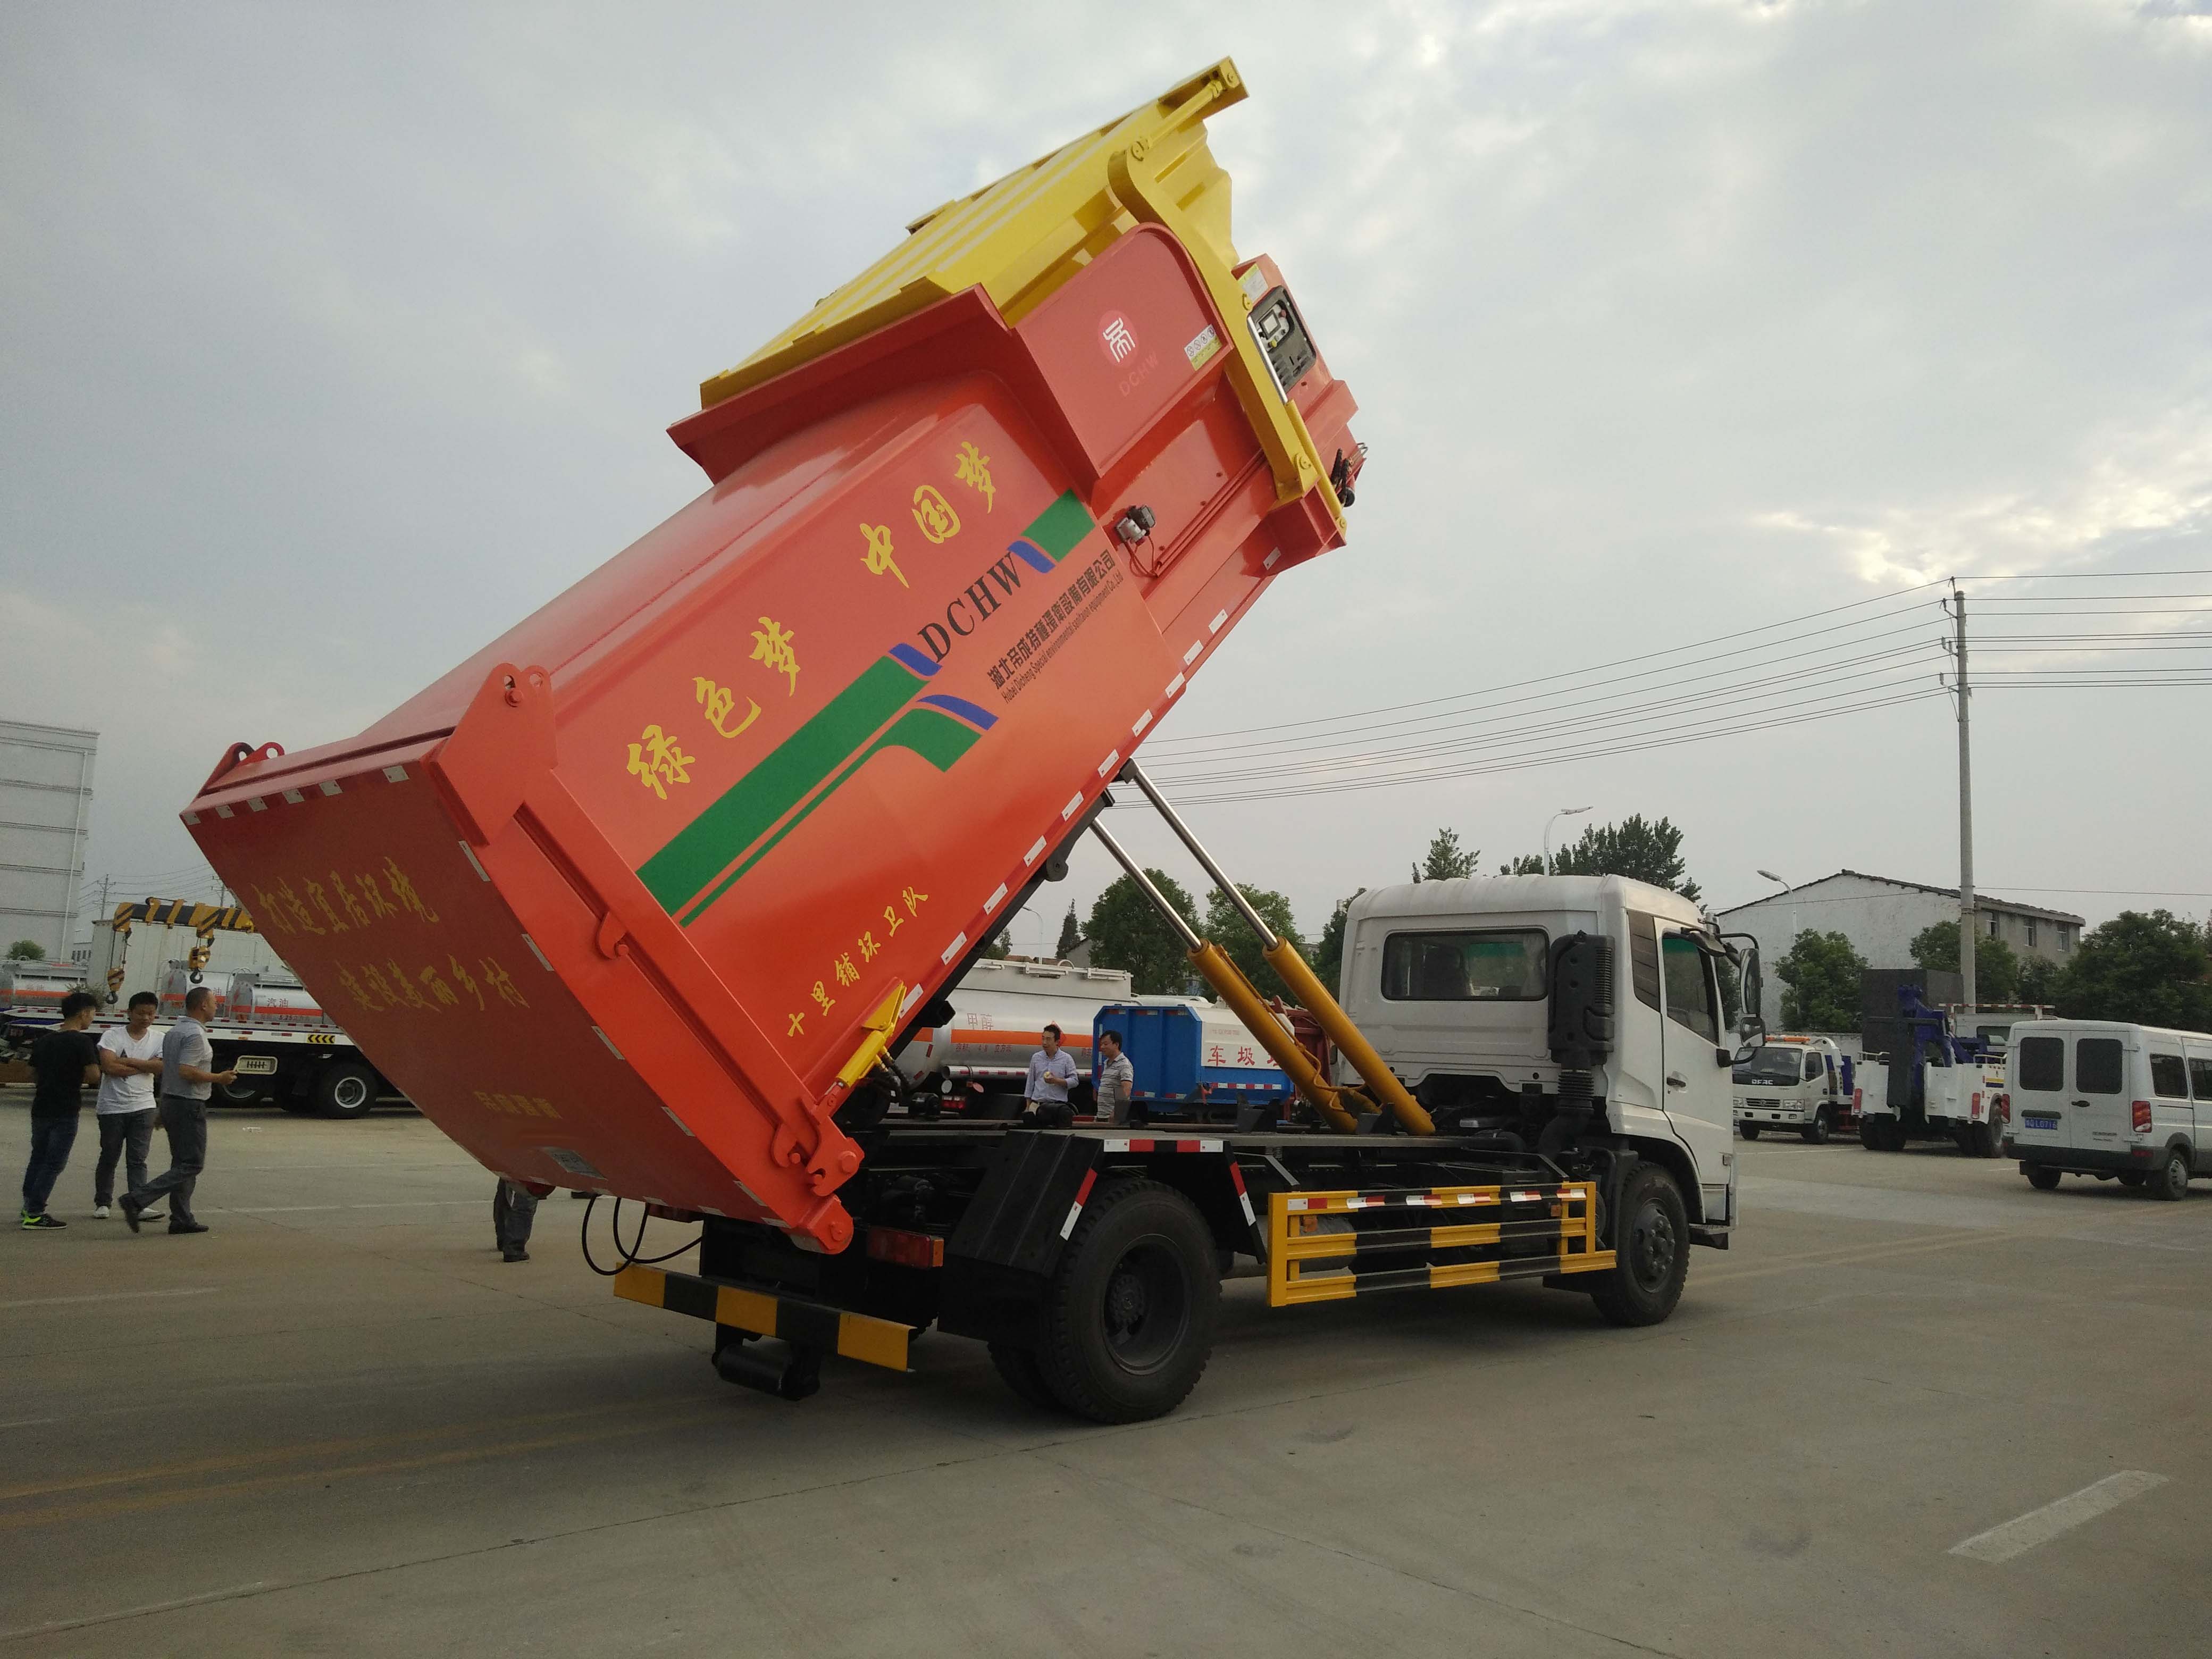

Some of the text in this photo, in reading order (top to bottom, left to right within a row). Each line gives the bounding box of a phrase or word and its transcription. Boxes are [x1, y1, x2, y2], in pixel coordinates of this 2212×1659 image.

[627, 442, 995, 800] 绿色梦 中国梦
[917, 551, 1021, 664] DCHW
[1001, 683, 1019, 704] Hubei
[1030, 650, 1049, 674] Special
[267, 998, 289, 1008] 汽油
[967, 1012, 994, 1030] 甲醇
